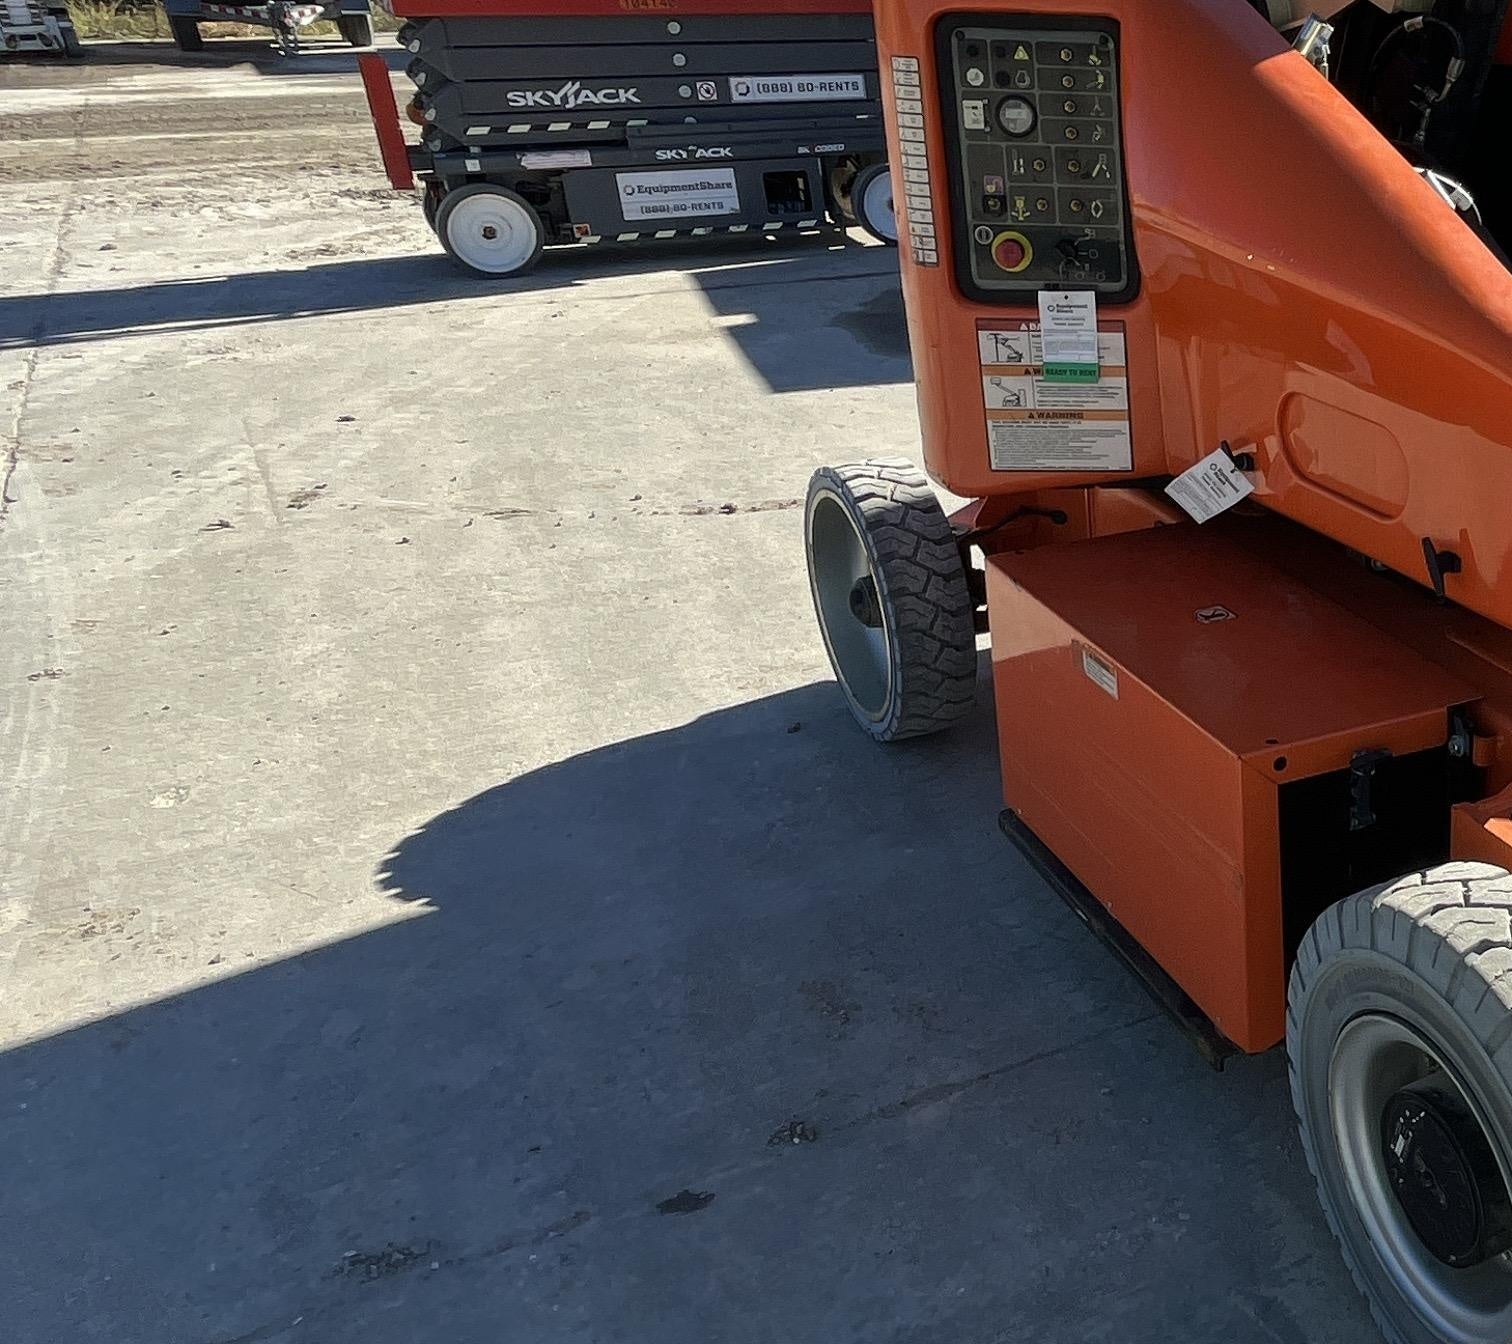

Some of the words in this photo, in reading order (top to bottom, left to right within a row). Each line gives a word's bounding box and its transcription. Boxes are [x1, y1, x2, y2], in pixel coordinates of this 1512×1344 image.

[756, 81, 793, 93] (888)
[797, 81, 860, 93] 80-RENTS
[506, 81, 641, 109] SKYJACK
[655, 145, 735, 161] SKYACK
[636, 181, 733, 195] EquipmentShare
